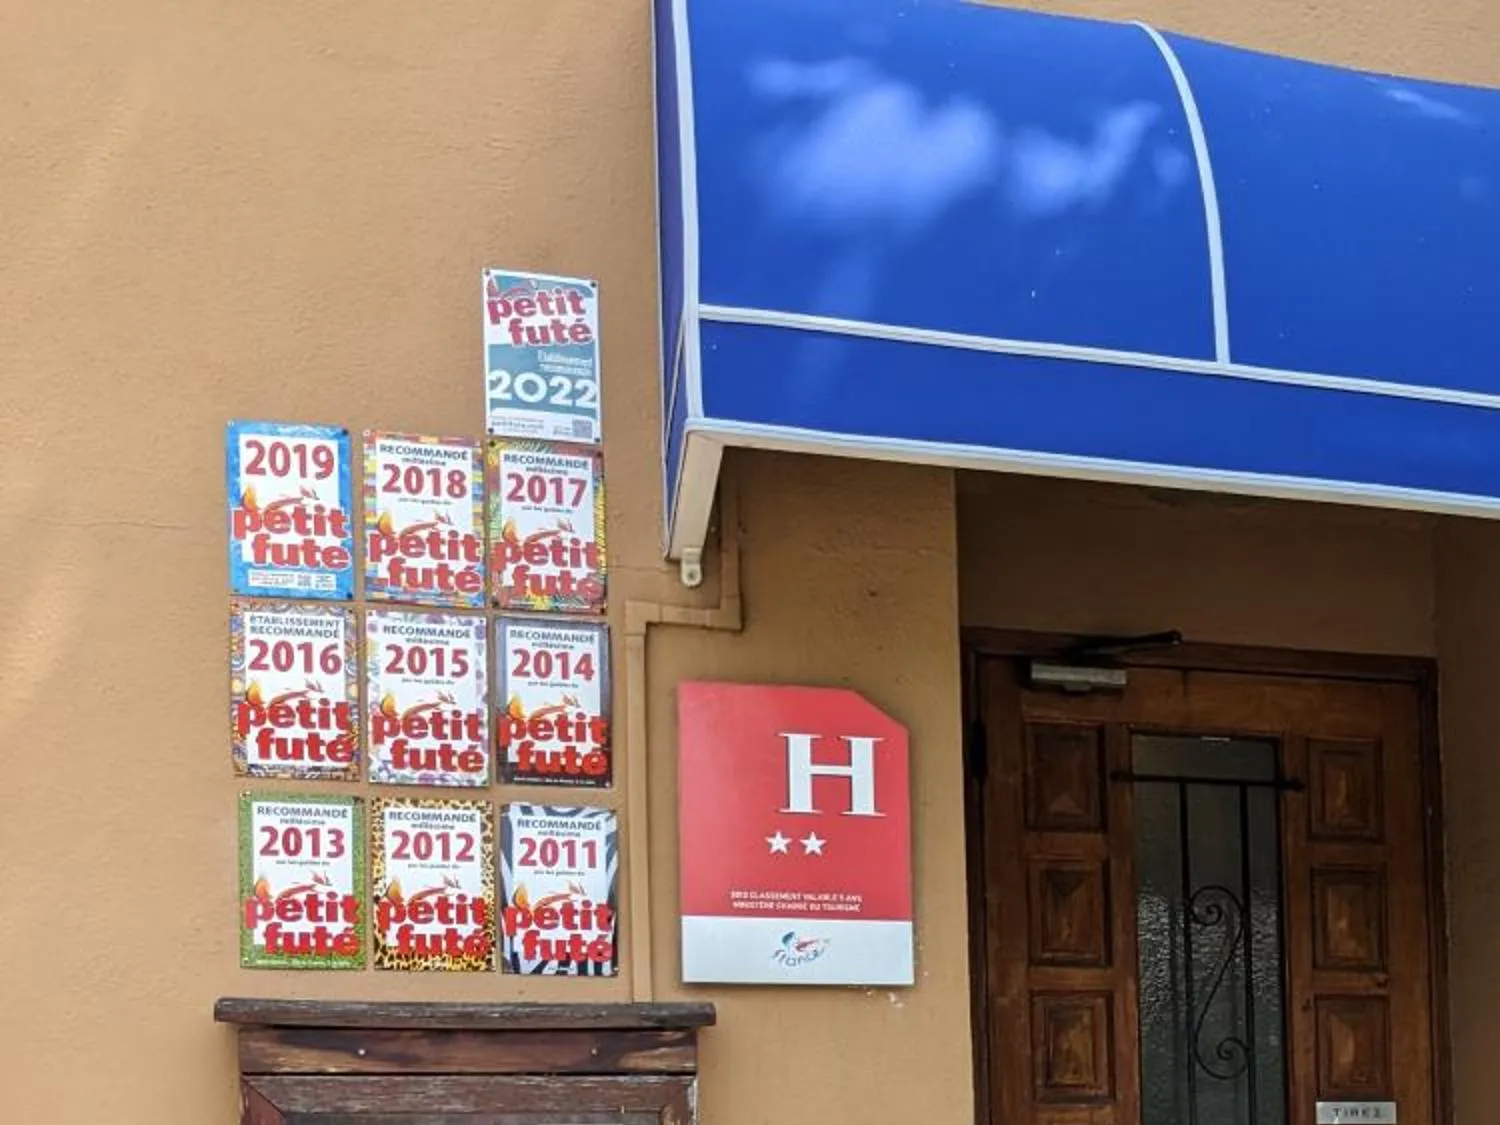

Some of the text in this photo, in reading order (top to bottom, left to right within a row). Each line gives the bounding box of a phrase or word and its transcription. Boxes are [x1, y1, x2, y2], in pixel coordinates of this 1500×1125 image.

[488, 287, 586, 325] petit
[509, 318, 592, 345] futé
[488, 370, 598, 408] 2022
[245, 440, 335, 480] 2019
[382, 463, 467, 498] 2018
[507, 473, 587, 507] 2017
[233, 504, 347, 540] petit
[369, 530, 481, 562] petit
[491, 538, 602, 571] petit
[388, 556, 482, 593] futé
[248, 639, 342, 675] 2016
[385, 644, 469, 678] 2015
[512, 648, 595, 681] 2014
[237, 698, 353, 735] petit
[372, 710, 482, 744] petit
[497, 712, 608, 746] petit
[256, 728, 354, 762] futé
[390, 738, 485, 772] futé
[777, 732, 887, 816] H
[259, 826, 345, 859] 2013
[391, 830, 475, 862] 2012
[518, 838, 598, 869] 2011
[245, 891, 360, 929] petit
[378, 894, 488, 931] petit
[504, 900, 613, 937] petit
[264, 922, 360, 957] futé
[396, 924, 489, 958] futé
[523, 930, 613, 962] futé
